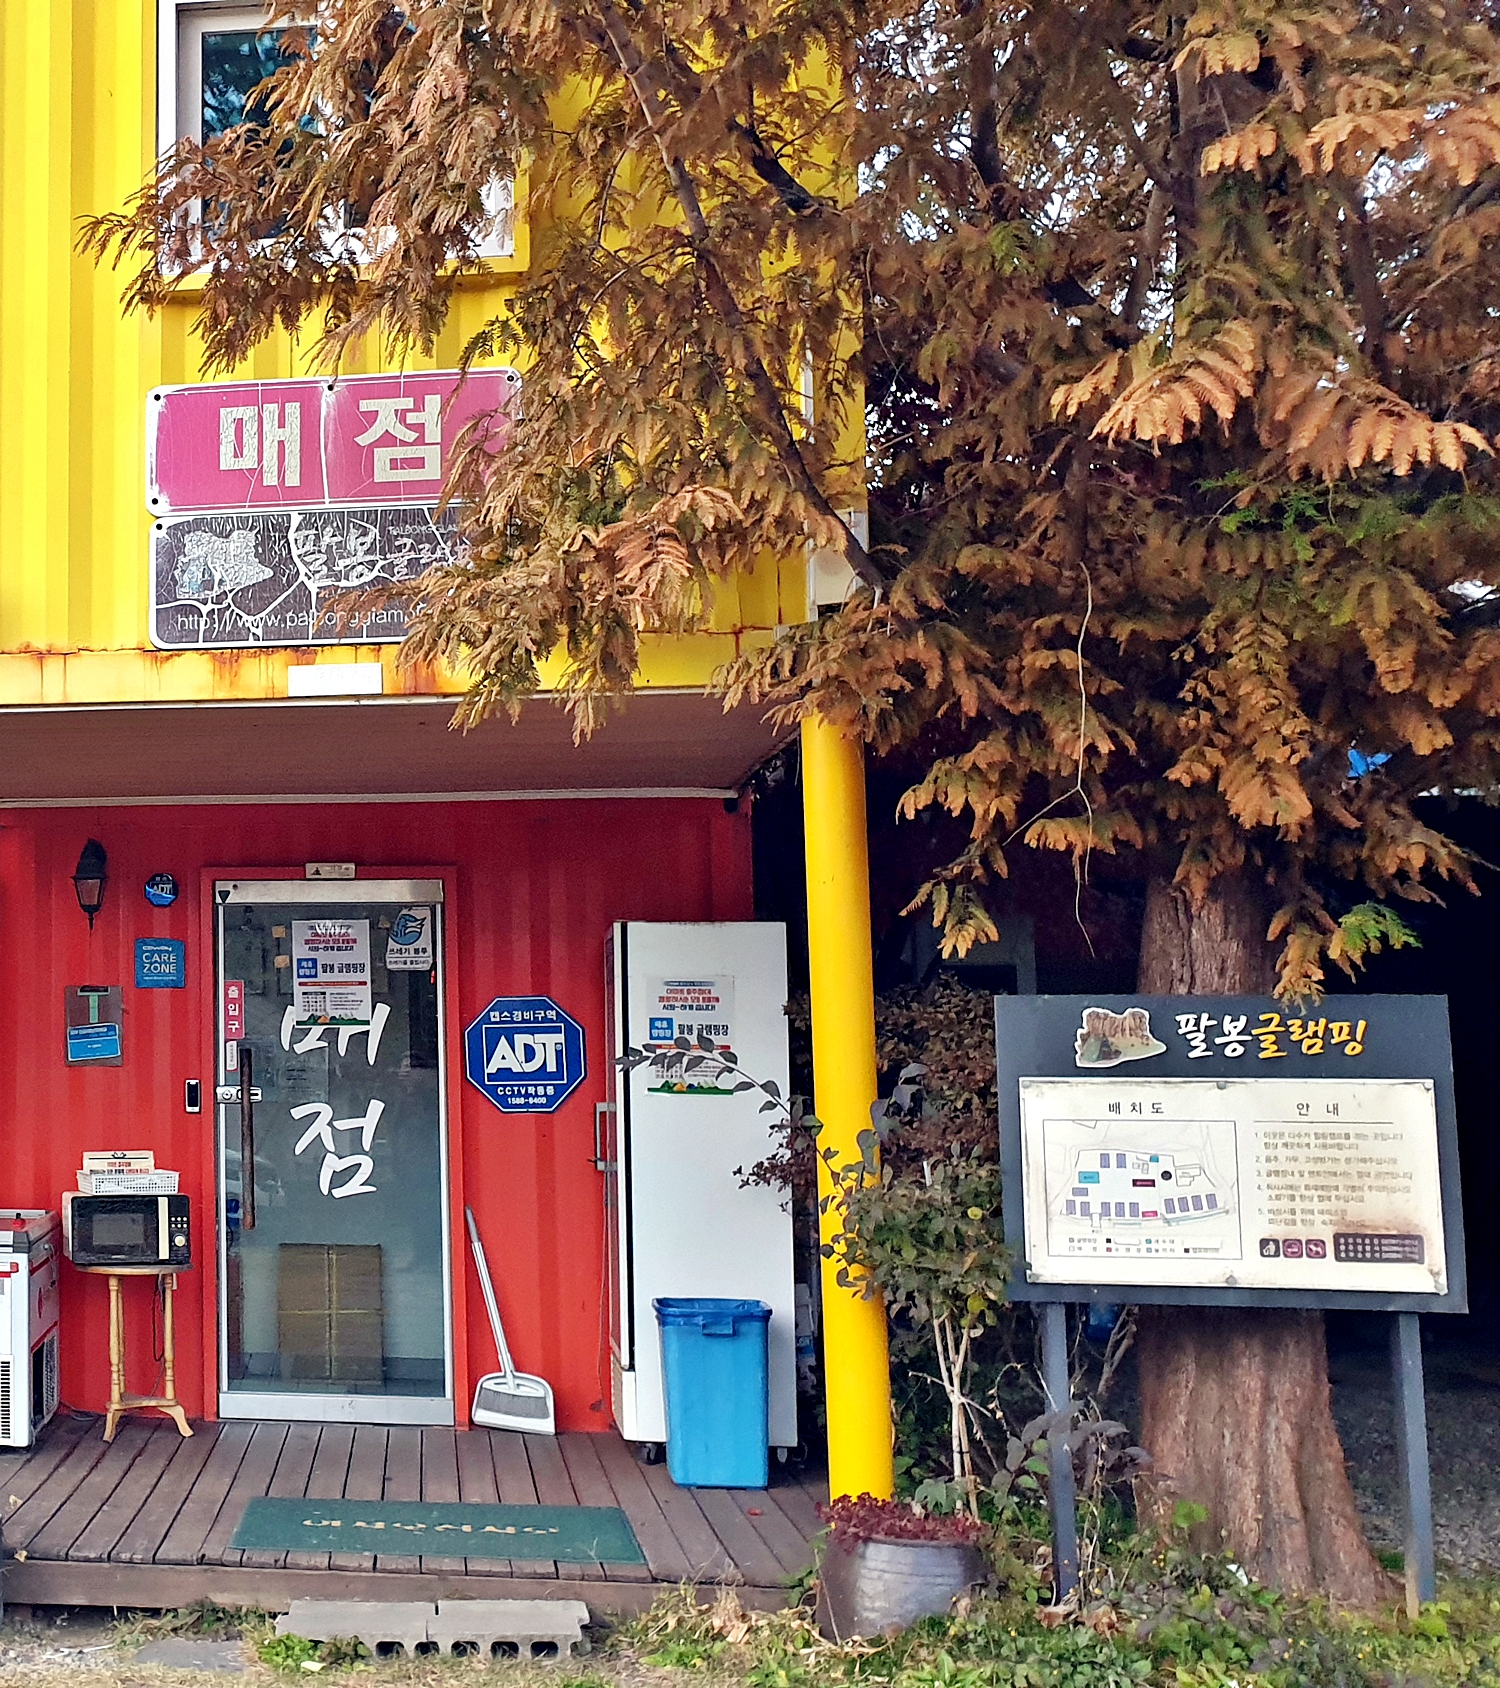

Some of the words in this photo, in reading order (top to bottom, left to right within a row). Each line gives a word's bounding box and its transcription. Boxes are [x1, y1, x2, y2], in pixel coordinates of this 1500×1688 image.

[142, 952, 177, 963] CARE
[142, 963, 177, 974] ZONE
[227, 985, 240, 1033] 출입구
[485, 1033, 564, 1073] ADT
